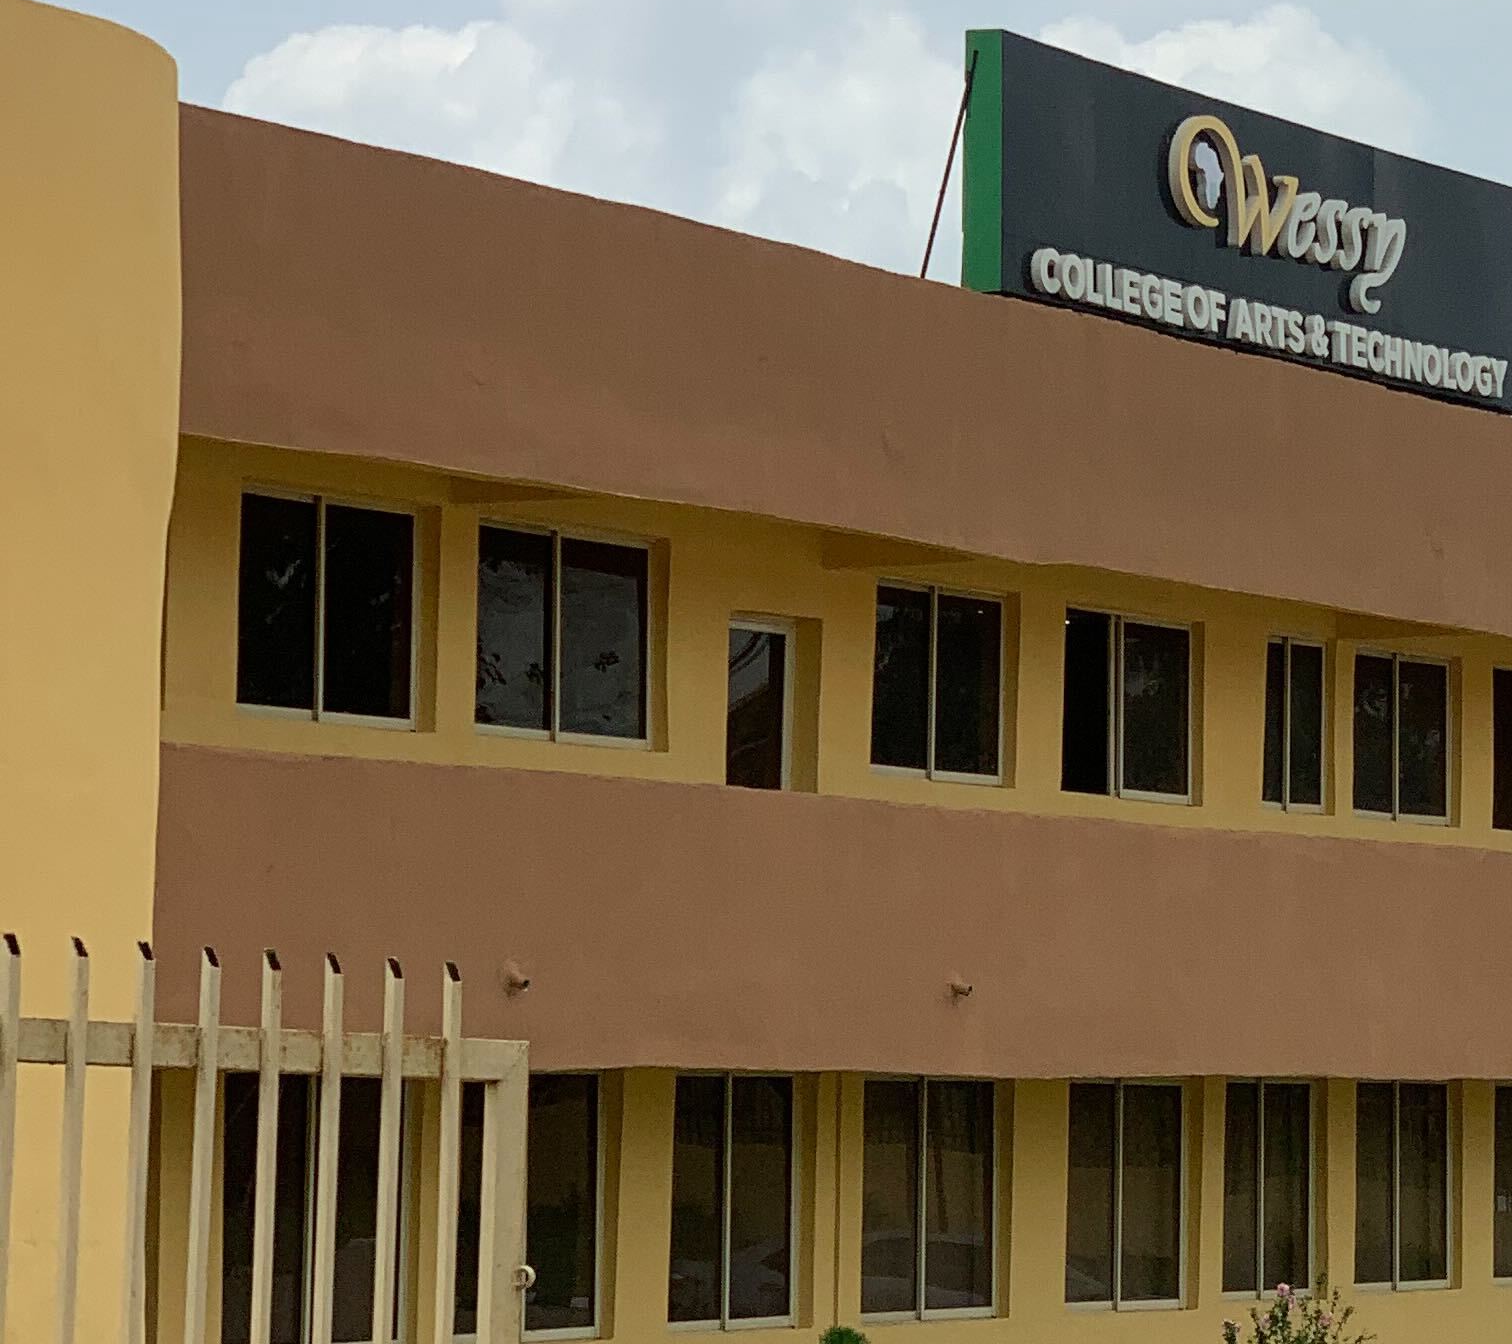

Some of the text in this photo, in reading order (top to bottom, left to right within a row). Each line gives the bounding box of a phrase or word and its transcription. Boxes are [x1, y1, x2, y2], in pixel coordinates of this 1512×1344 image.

[1031, 247, 1508, 398] COLLEGE OF ARTS & TECHNOLOGY
